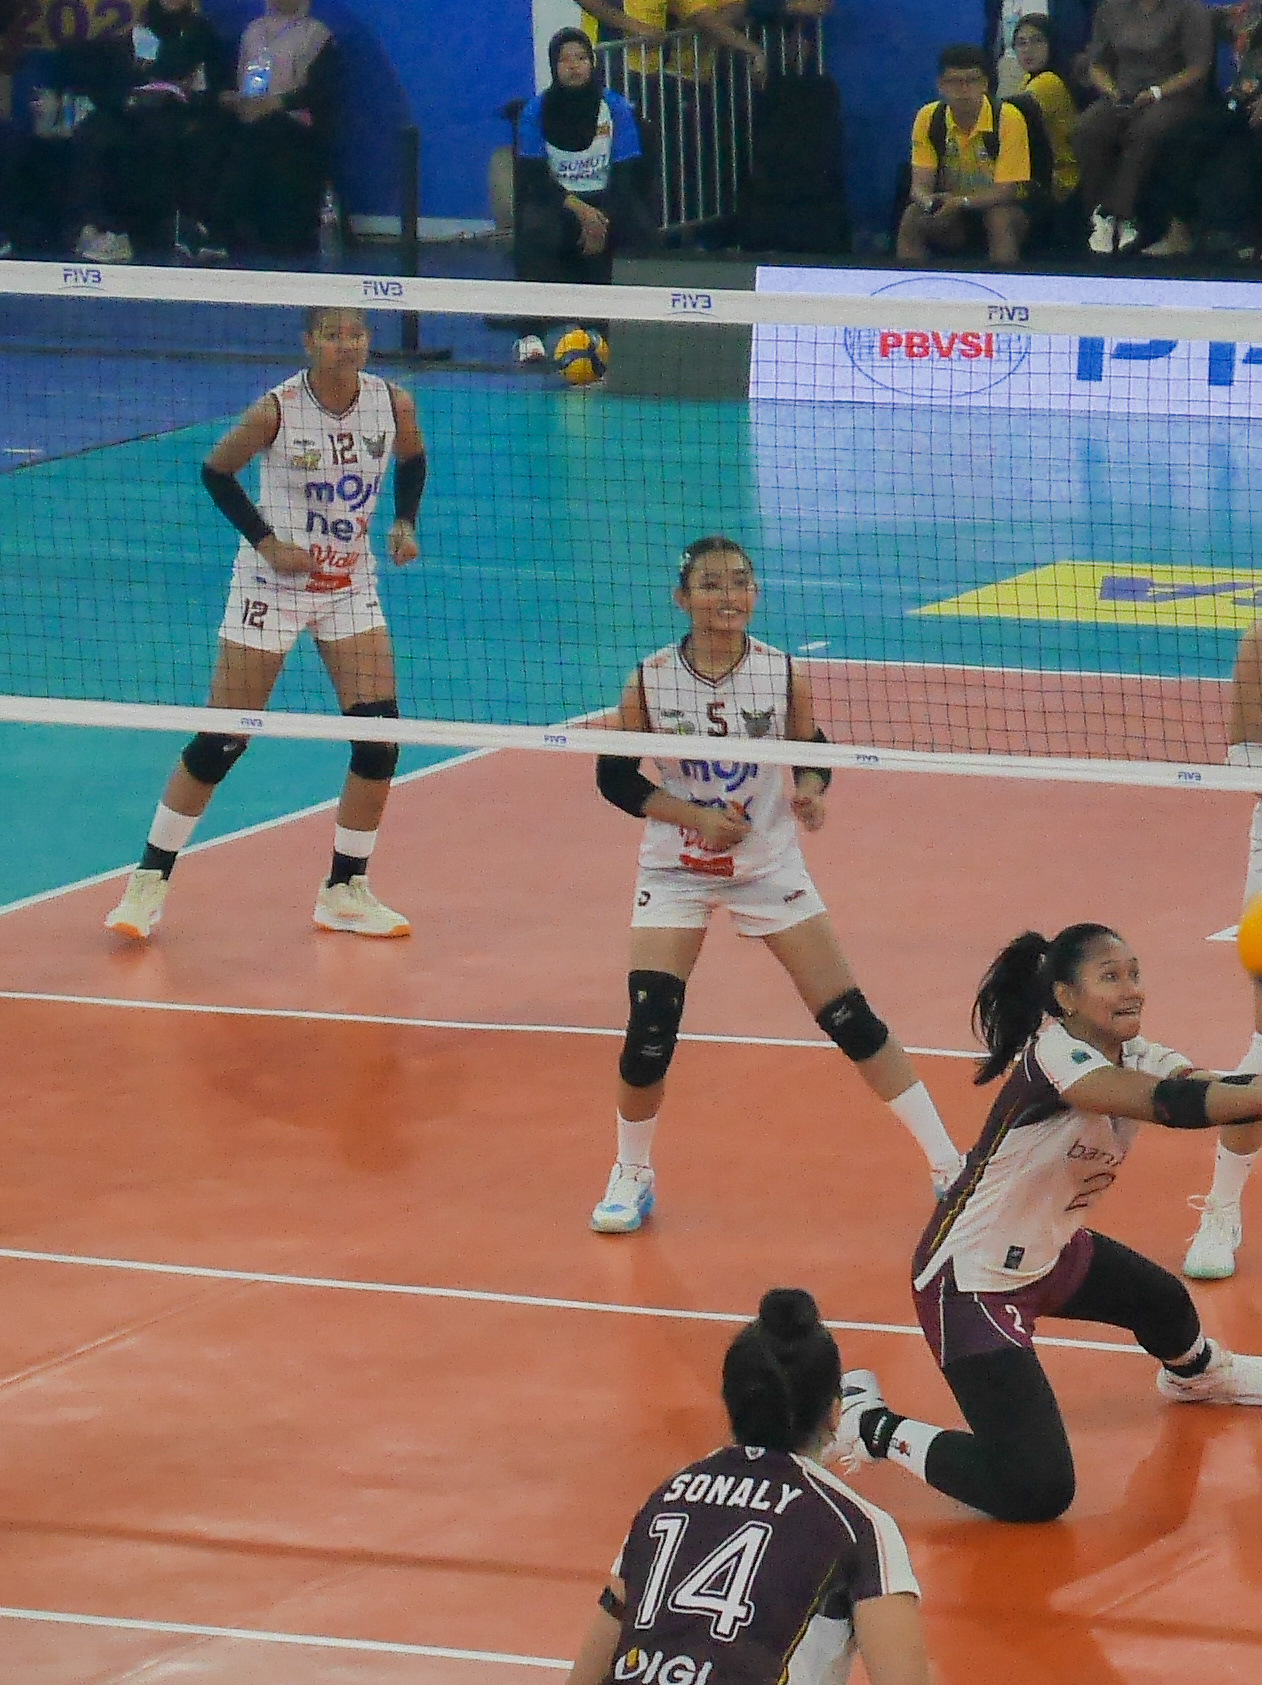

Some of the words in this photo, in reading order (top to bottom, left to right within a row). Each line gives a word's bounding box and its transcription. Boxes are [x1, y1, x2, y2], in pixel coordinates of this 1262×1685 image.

[63, 268, 102, 284] FIVB
[362, 281, 403, 297] FIVB
[671, 293, 712, 309] FIVB
[987, 305, 1029, 321] FIVB
[878, 330, 995, 360] PBVSI
[328, 432, 358, 465] 12
[241, 597, 269, 629] 12
[706, 700, 729, 737] 5
[1004, 1303, 1027, 1334] 2
[663, 1472, 803, 1515] SONALY
[634, 1512, 773, 1643] 14
[614, 1646, 714, 1685] DIGI
